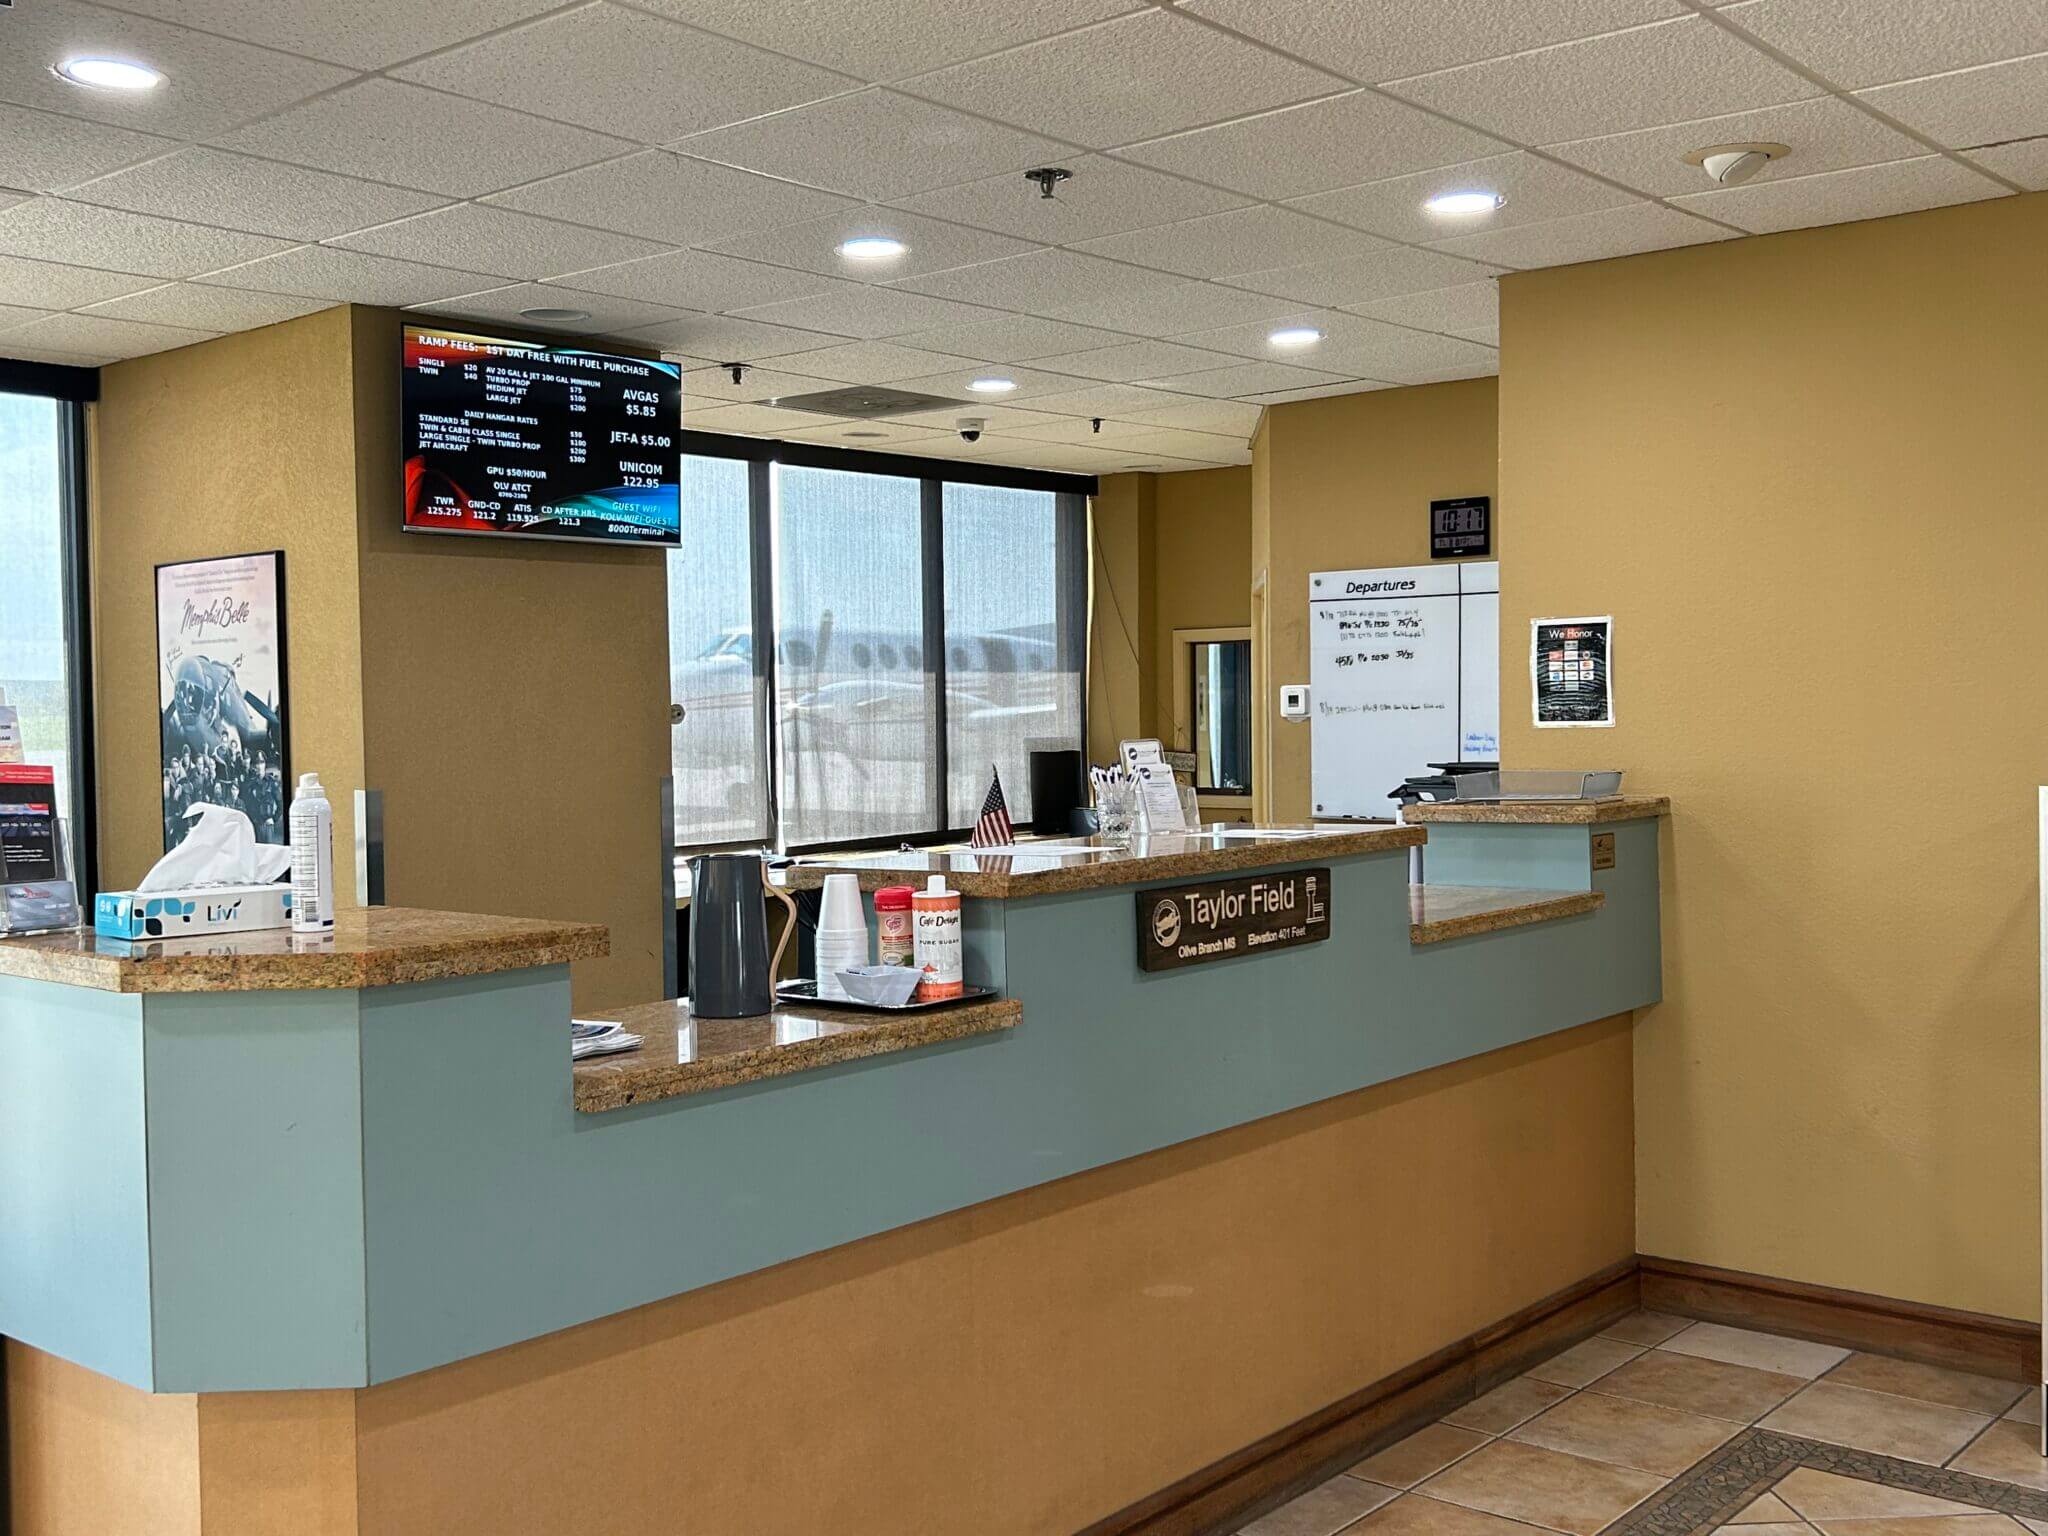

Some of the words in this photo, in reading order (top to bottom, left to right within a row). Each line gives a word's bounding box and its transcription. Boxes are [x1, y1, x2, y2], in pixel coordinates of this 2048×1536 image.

[418, 336, 448, 347] RAMP
[450, 340, 478, 352] FEES:
[486, 345, 503, 356] 1ST
[506, 348, 526, 359] DAY
[528, 352, 550, 362] FREE
[553, 355, 576, 366] WITH
[580, 358, 602, 370] FUEL
[604, 362, 649, 376] PURCHASE
[419, 358, 445, 367] SINGLE
[464, 364, 478, 372] $20
[419, 366, 439, 375] TWIN
[486, 375, 510, 384] TURBO
[512, 377, 530, 387] PROP
[497, 368, 506, 376] 20
[508, 369, 521, 378] GAL
[530, 371, 540, 380] JET
[556, 375, 568, 384] GAL
[570, 378, 601, 388] MINIMUM
[486, 384, 515, 393] MEDIUM
[516, 387, 527, 396] JET
[570, 395, 586, 403] $100
[486, 394, 509, 402] LARGE
[510, 396, 521, 405] JET
[623, 389, 659, 404] AVGAS
[570, 404, 586, 412] $200
[626, 404, 656, 417] $5.85
[419, 414, 458, 425] STANDARD
[464, 410, 484, 419] DAILY
[486, 413, 515, 423] HANGAR
[517, 417, 538, 425] RATES
[419, 423, 439, 431] TWIN
[440, 424, 446, 432] &
[448, 425, 470, 435] CABIN
[472, 428, 494, 437] CLASS
[495, 430, 520, 440] SINGLE
[419, 432, 443, 440] LARGE
[445, 434, 470, 443] SINGLE
[477, 438, 495, 446] TWIN
[497, 439, 520, 448] TURBO
[522, 442, 541, 450] PROP
[610, 431, 638, 444] JET-A
[641, 435, 671, 447] $5.00
[419, 441, 430, 449] JET
[433, 442, 468, 452] AIRCRAFT
[487, 466, 504, 475] GPU
[506, 468, 547, 479] $50/HOUR
[619, 461, 663, 475] UNICOM
[493, 481, 509, 490] OLV
[511, 483, 532, 492] ATCT
[623, 476, 659, 489] 122.95
[434, 496, 454, 505] TWR
[468, 500, 501, 510] GND-CD
[613, 502, 640, 512] GUEST
[427, 506, 462, 517] 125.275
[513, 504, 532, 513] ATIS
[541, 506, 552, 514] CD
[554, 506, 579, 516] AFTER
[473, 511, 496, 520] 121.2
[559, 517, 580, 526] 121.3
[1442, 508, 1482, 532] 10:17
[1346, 580, 1416, 596] Departures
[180, 598, 222, 638] Memphis
[220, 596, 250, 628] Belle
[1549, 629, 1564, 639] We
[1567, 628, 1593, 639] Honor
[1185, 889, 1246, 930] Taylor
[1251, 880, 1295, 915] Field
[1248, 930, 1278, 946] Elevation
[1278, 927, 1291, 939] 401
[1291, 926, 1306, 938] Feet
[1178, 944, 1198, 959] Olive
[1198, 940, 1223, 955] Branch
[1223, 936, 1236, 950] MS
